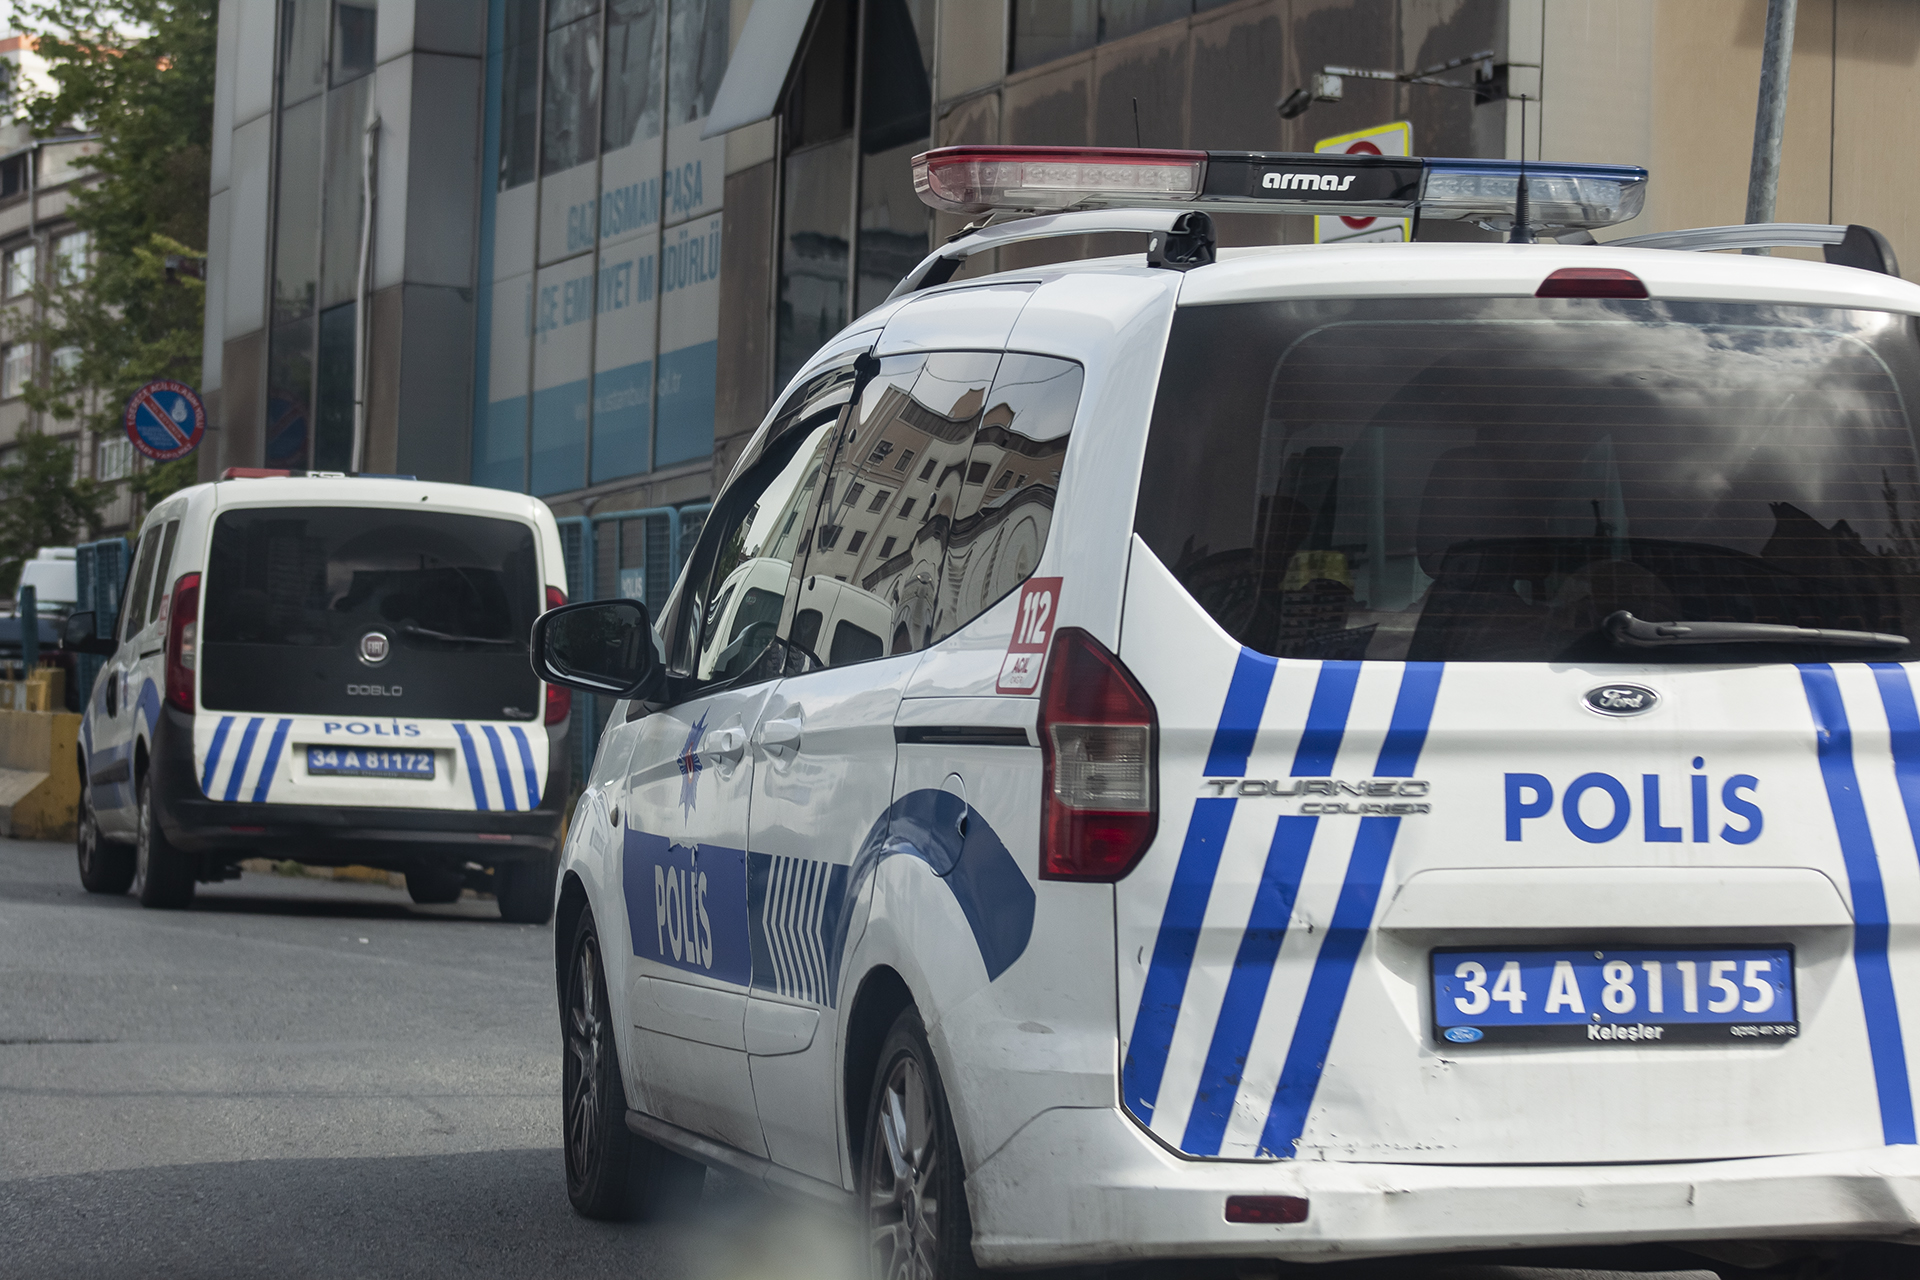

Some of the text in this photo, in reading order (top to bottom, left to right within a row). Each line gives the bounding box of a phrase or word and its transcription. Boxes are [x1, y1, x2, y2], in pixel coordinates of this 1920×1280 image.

[1262, 172, 1356, 191] armas
[1017, 590, 1052, 644] 112
[367, 640, 384, 654] FIAT
[347, 684, 402, 696] DOBLO
[1600, 689, 1644, 708] Ford
[324, 718, 421, 737] POLİS
[313, 751, 430, 771] 34 A 81172
[1208, 779, 1431, 797] TOURNEO
[1301, 802, 1431, 815] COURIER
[1504, 756, 1764, 845] POLİS
[654, 848, 713, 970] POLİS
[1454, 960, 1775, 1015] 34 A 81155
[1587, 1023, 1664, 1042] Keleşler
